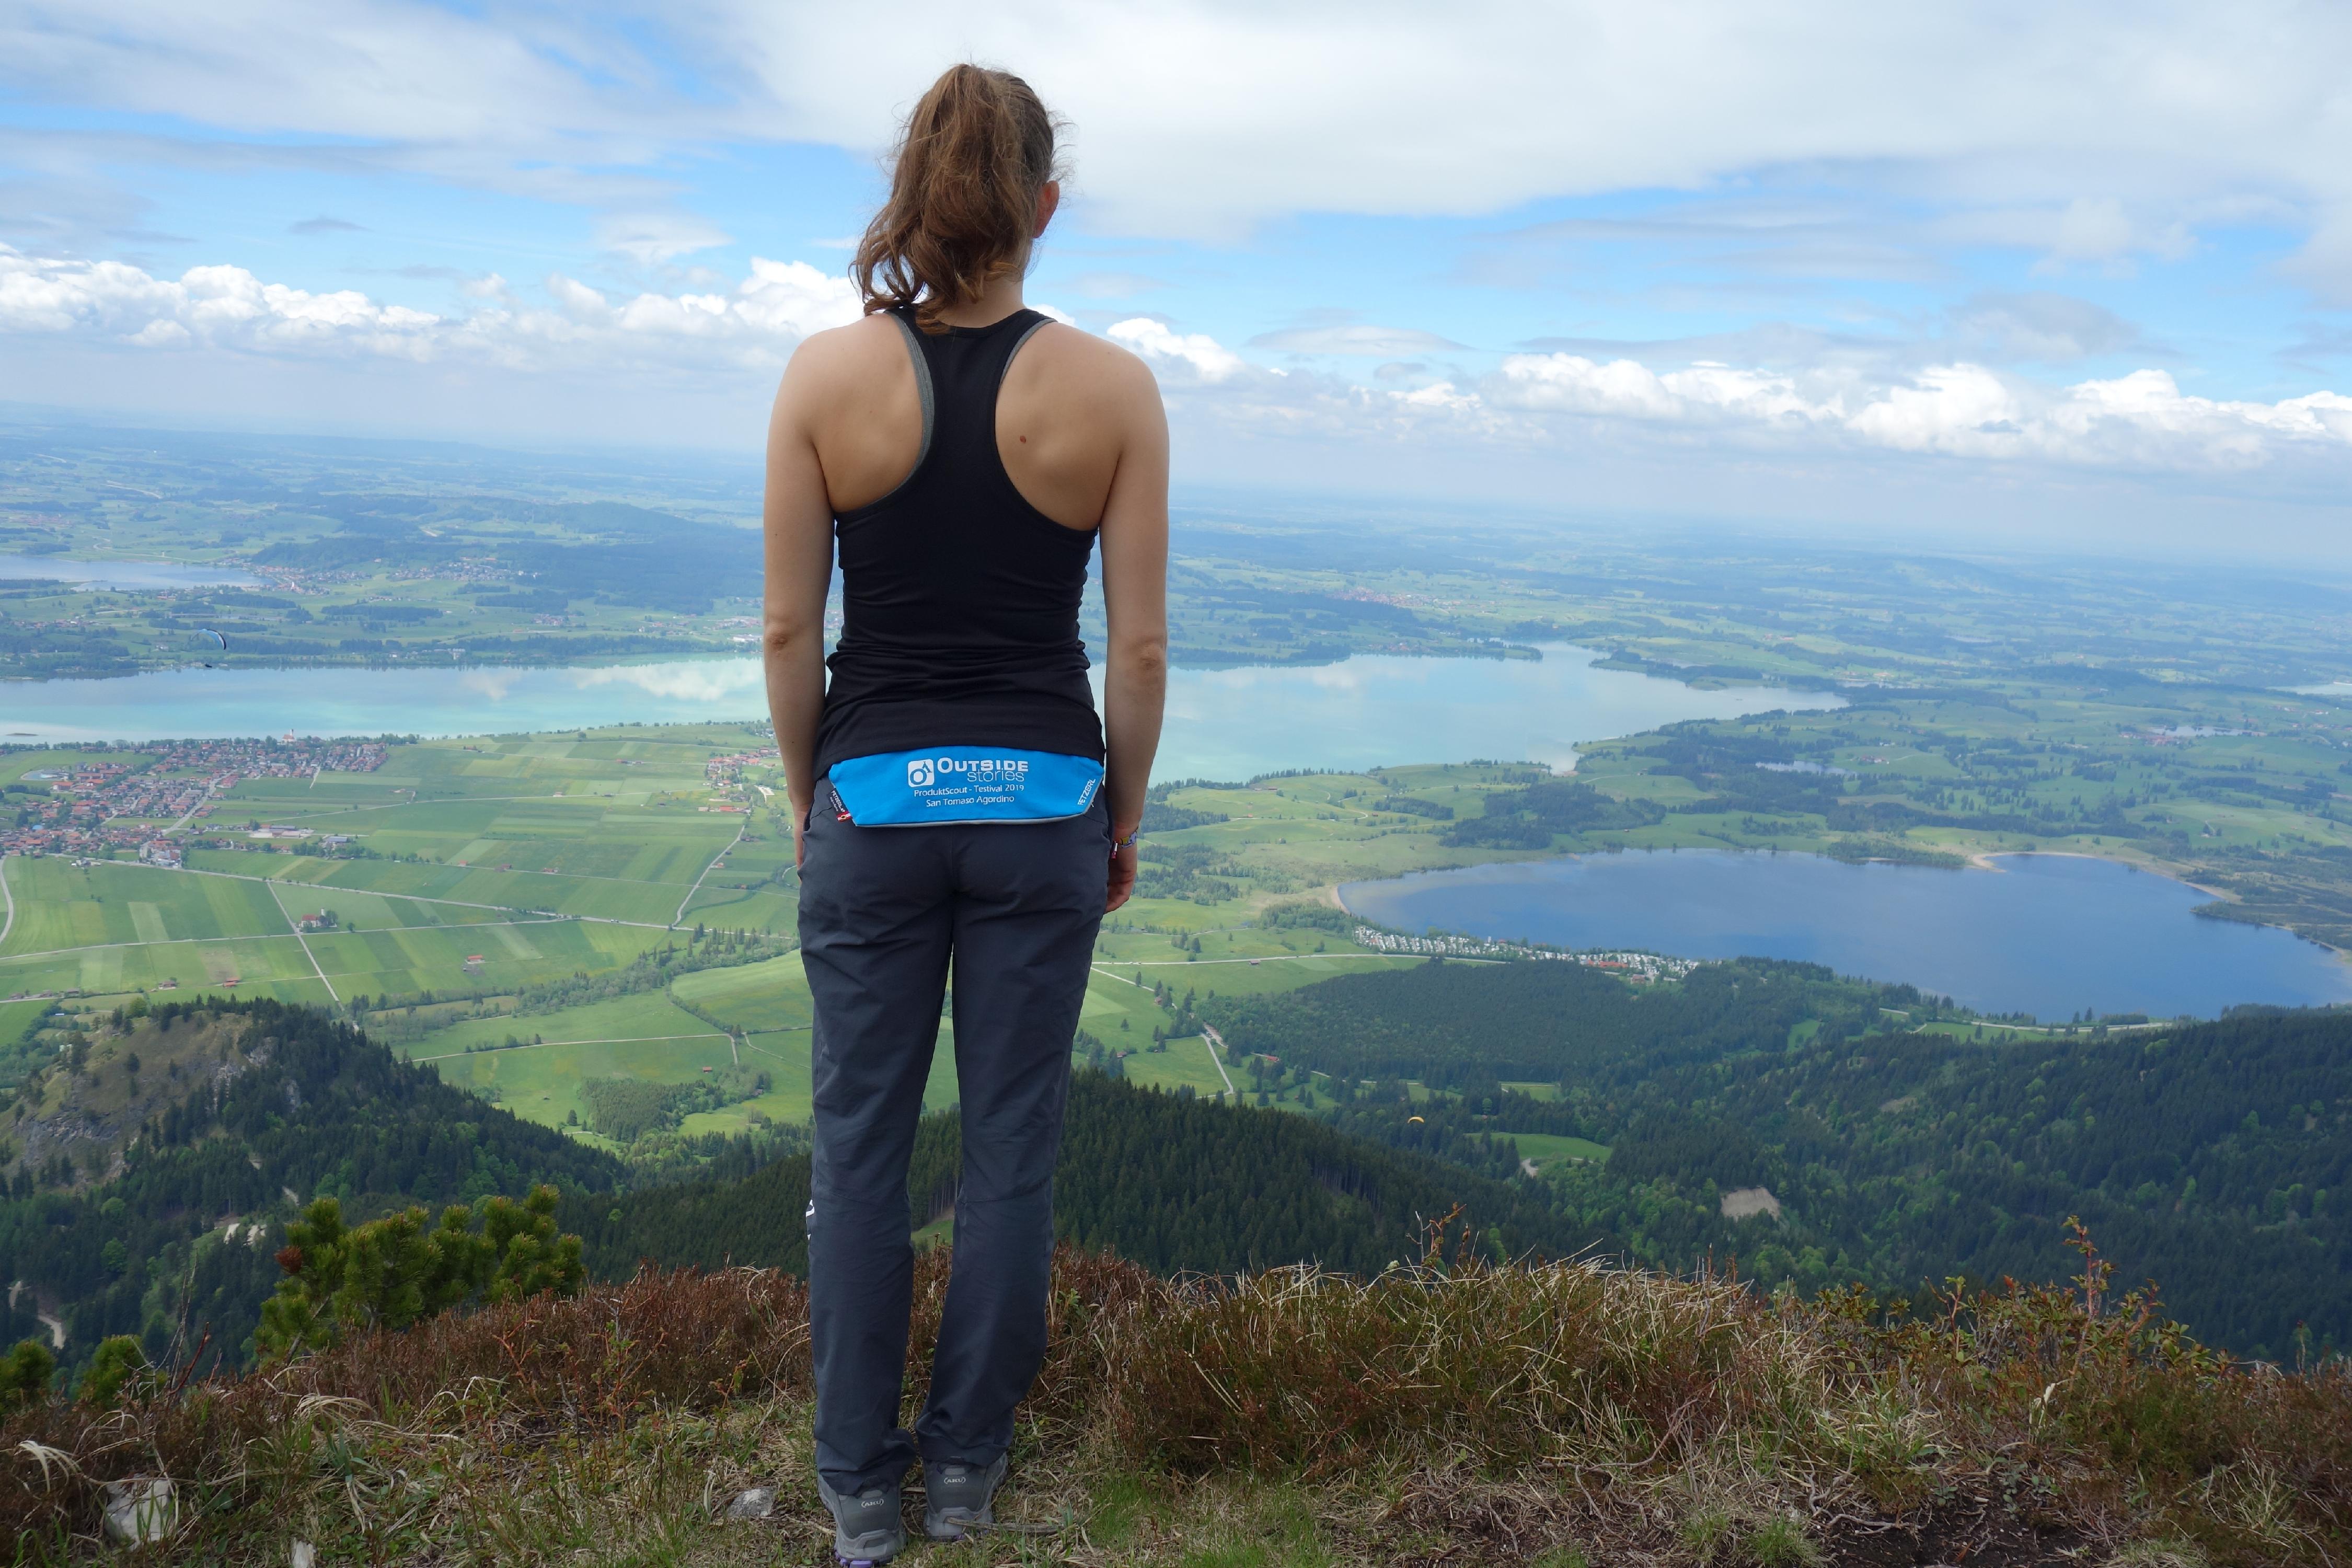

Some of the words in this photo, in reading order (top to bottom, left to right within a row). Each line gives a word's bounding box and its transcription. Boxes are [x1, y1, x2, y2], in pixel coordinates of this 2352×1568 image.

[937, 757, 1029, 773] OUTSIDE
[967, 767, 1024, 782] stories
[914, 787, 967, 797] ProduktScout
[1077, 779, 1096, 805] FETZERL
[976, 795, 1014, 805] Agordino
